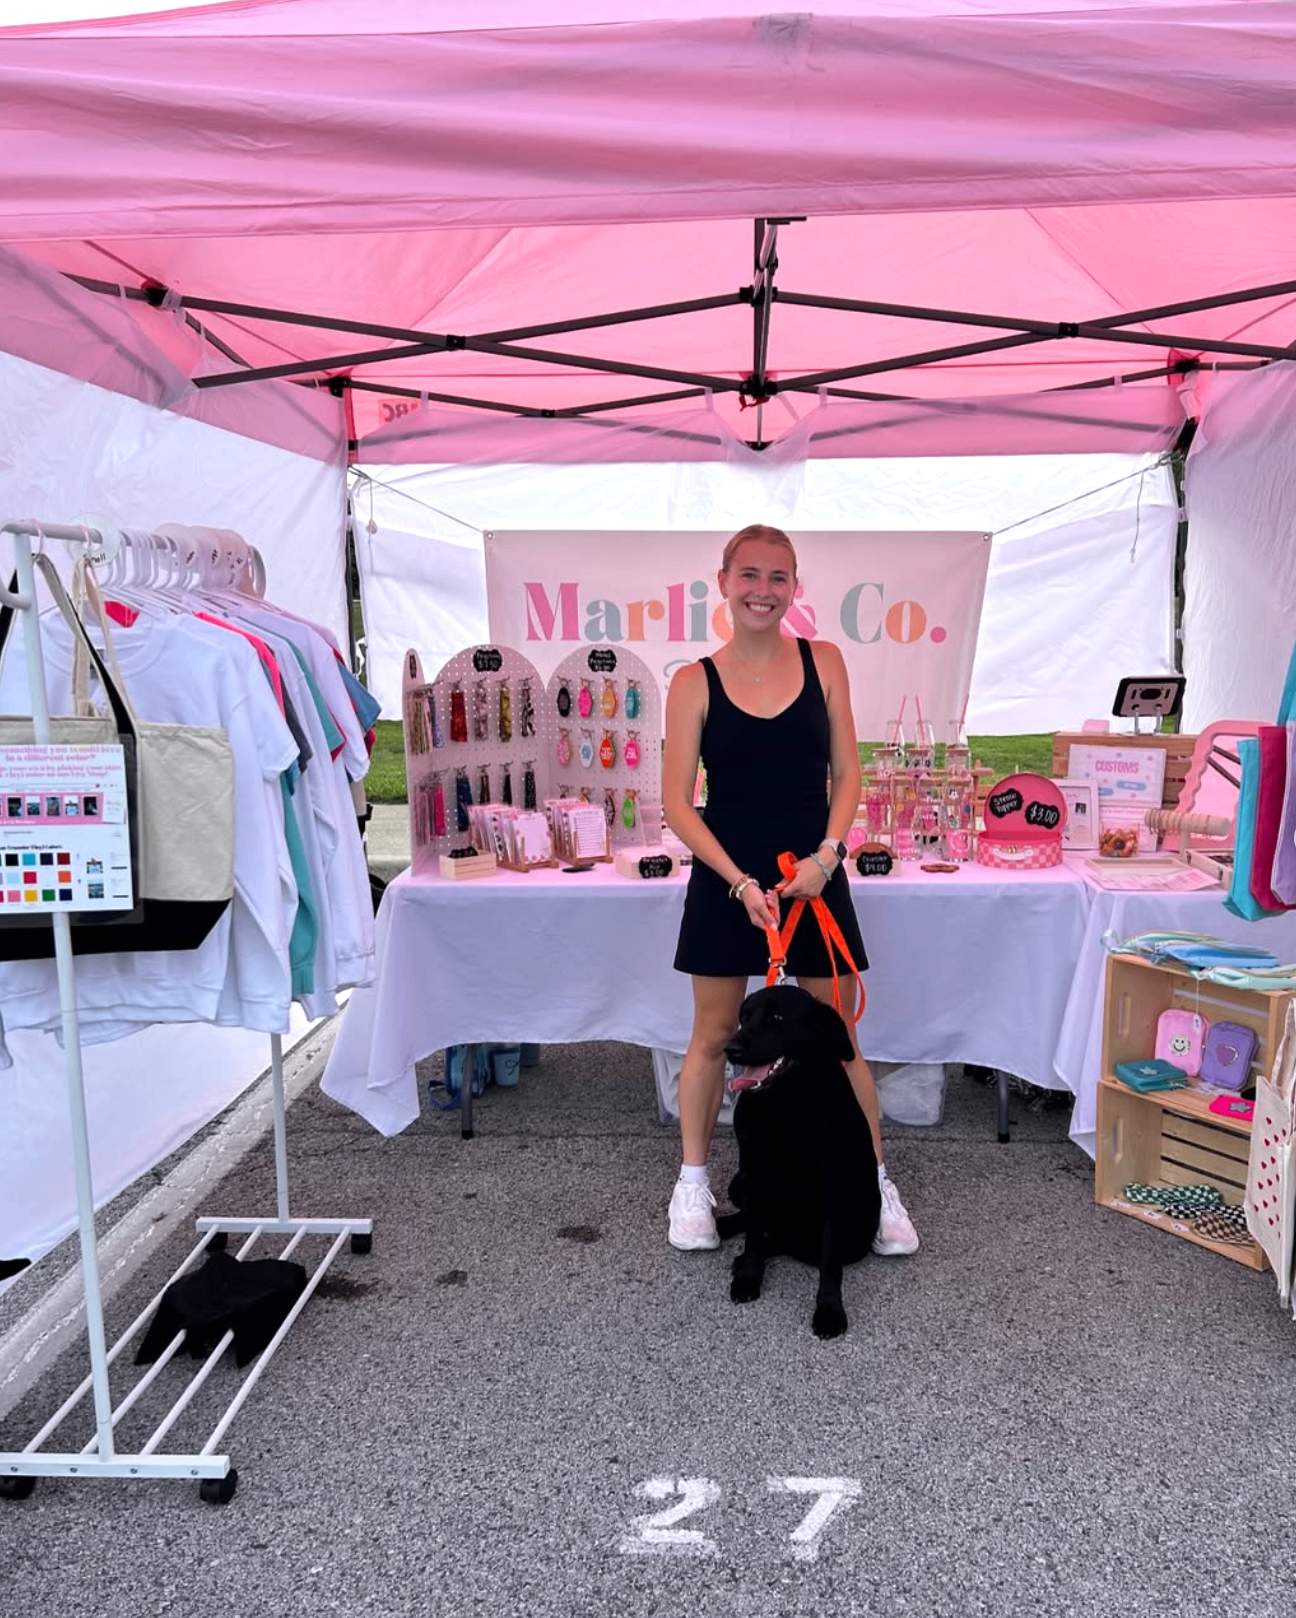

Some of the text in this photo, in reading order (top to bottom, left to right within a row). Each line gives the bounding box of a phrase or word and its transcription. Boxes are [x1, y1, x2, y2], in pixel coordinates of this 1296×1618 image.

[839, 582, 947, 643] Co.
[1095, 760, 1139, 773] CUSTOMS
[1030, 804, 1058, 824] $3.00
